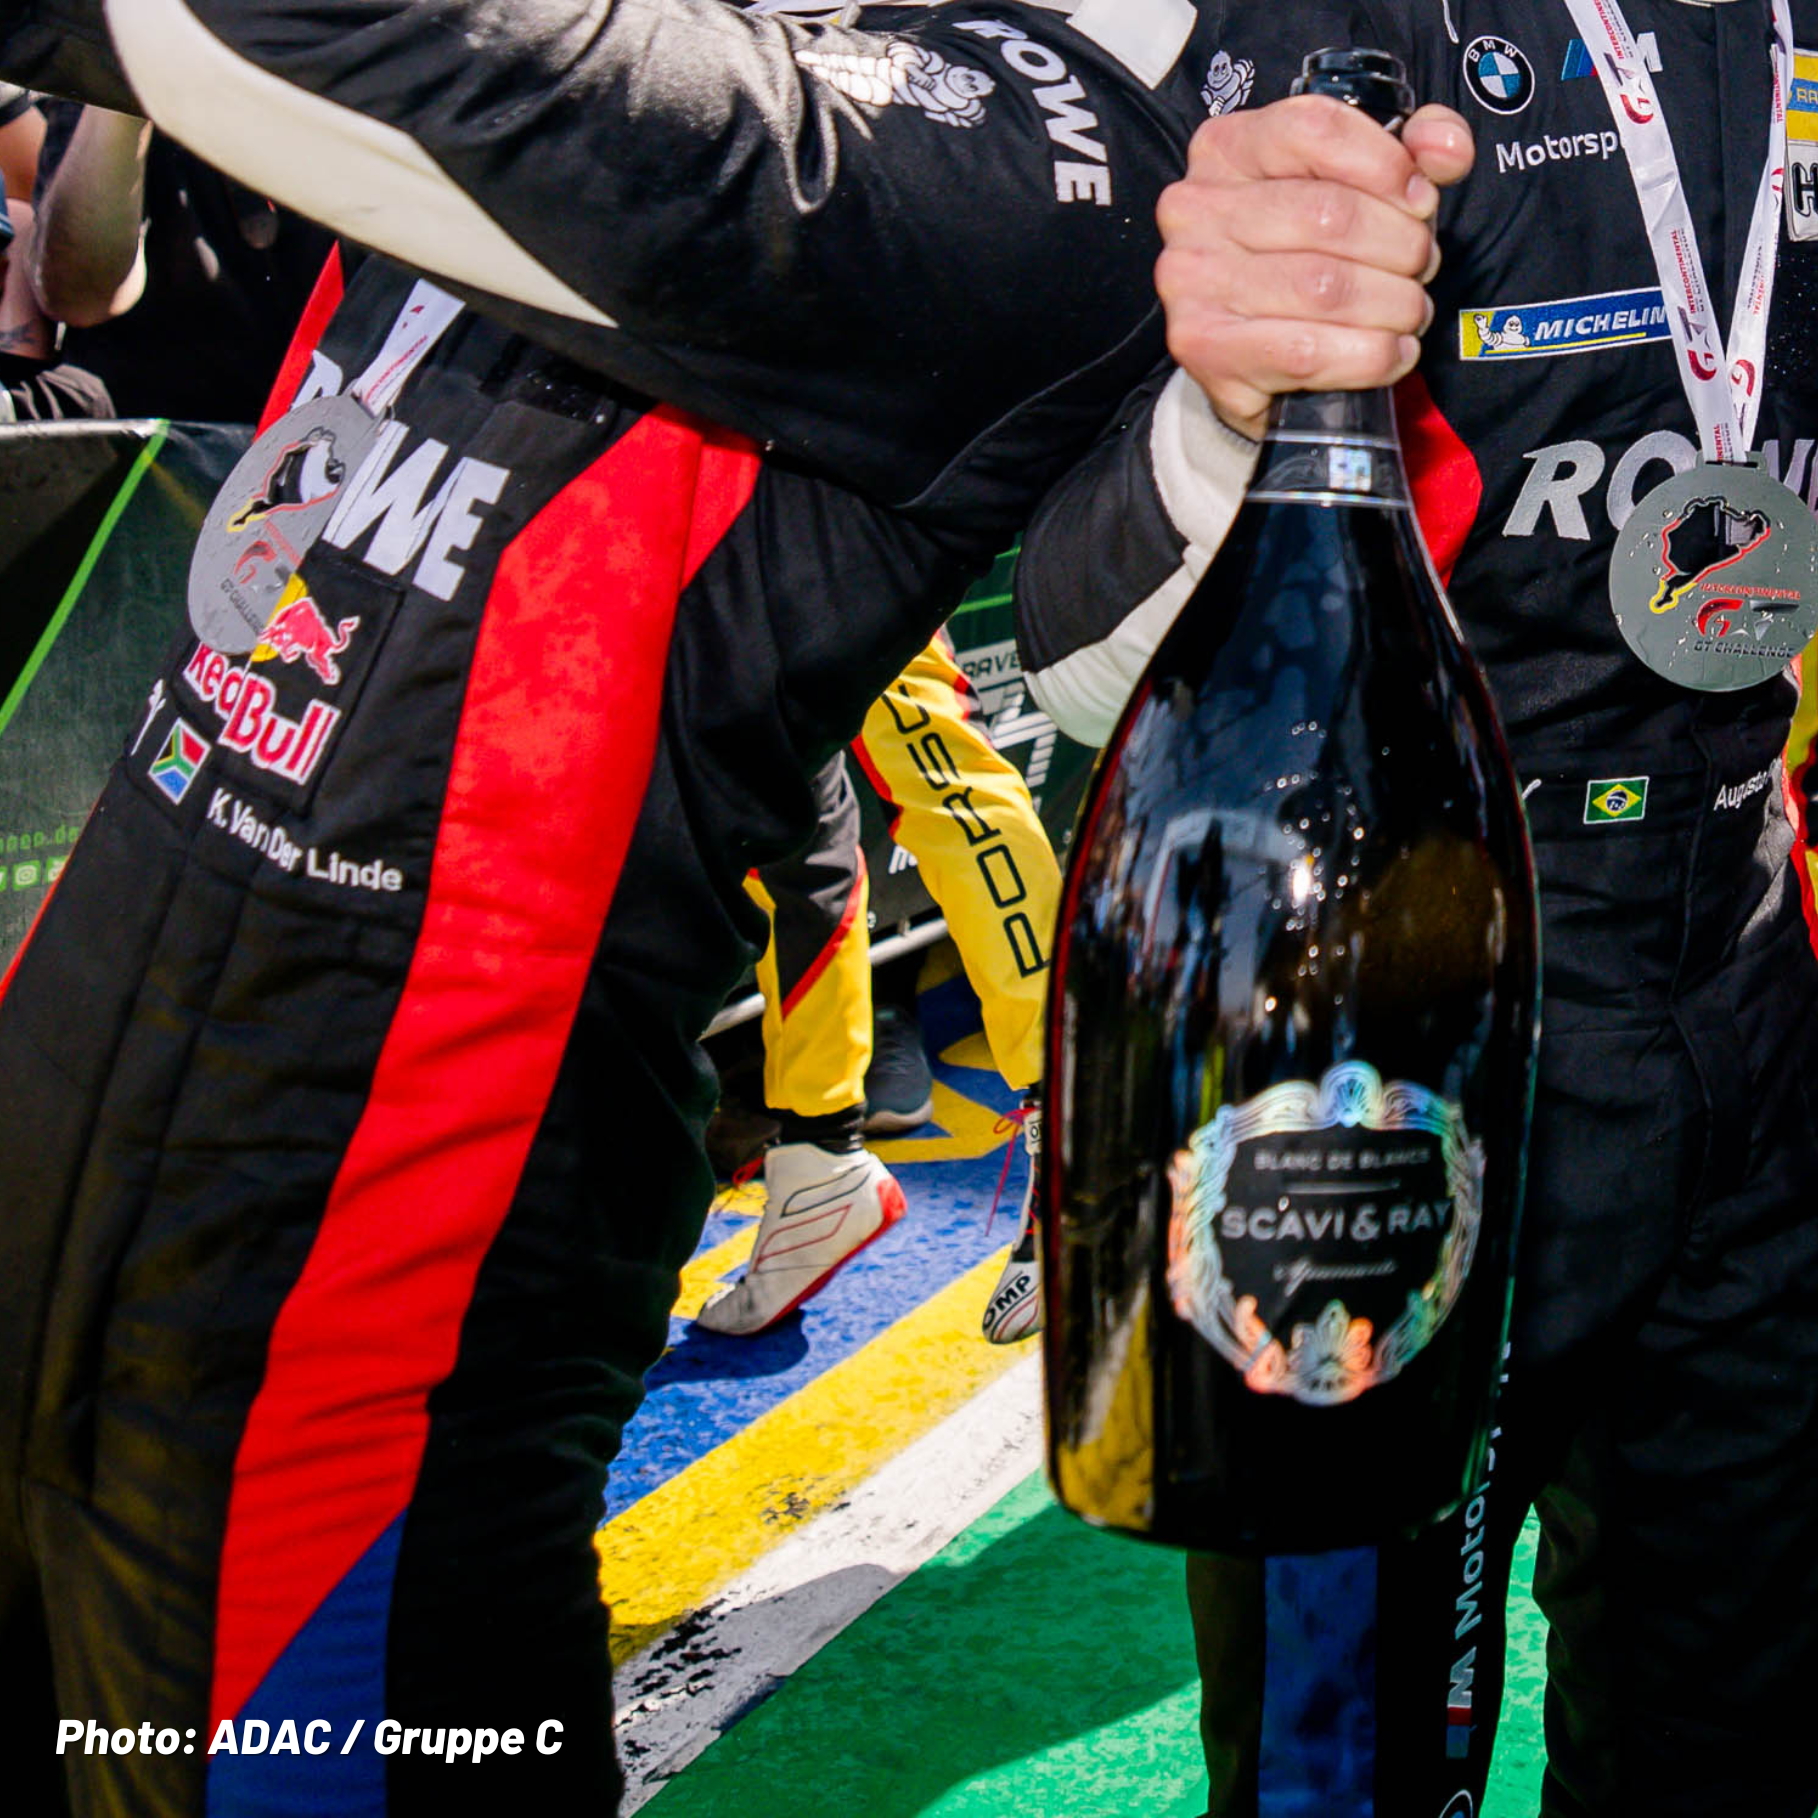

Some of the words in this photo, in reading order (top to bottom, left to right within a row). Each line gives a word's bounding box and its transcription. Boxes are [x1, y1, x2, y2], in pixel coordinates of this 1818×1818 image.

[951, 18, 1113, 208] ROWE
[1495, 131, 1619, 173] Motorsp
[1671, 229, 1697, 314] INTERCONTINENTAL
[1715, 641, 1797, 660] CHALLENGE
[880, 682, 1051, 979] PORSC
[306, 846, 405, 892] Linde
[1221, 1204, 1346, 1242] SCAVI
[1350, 1204, 1381, 1243] &
[1387, 1196, 1453, 1235] RAY
